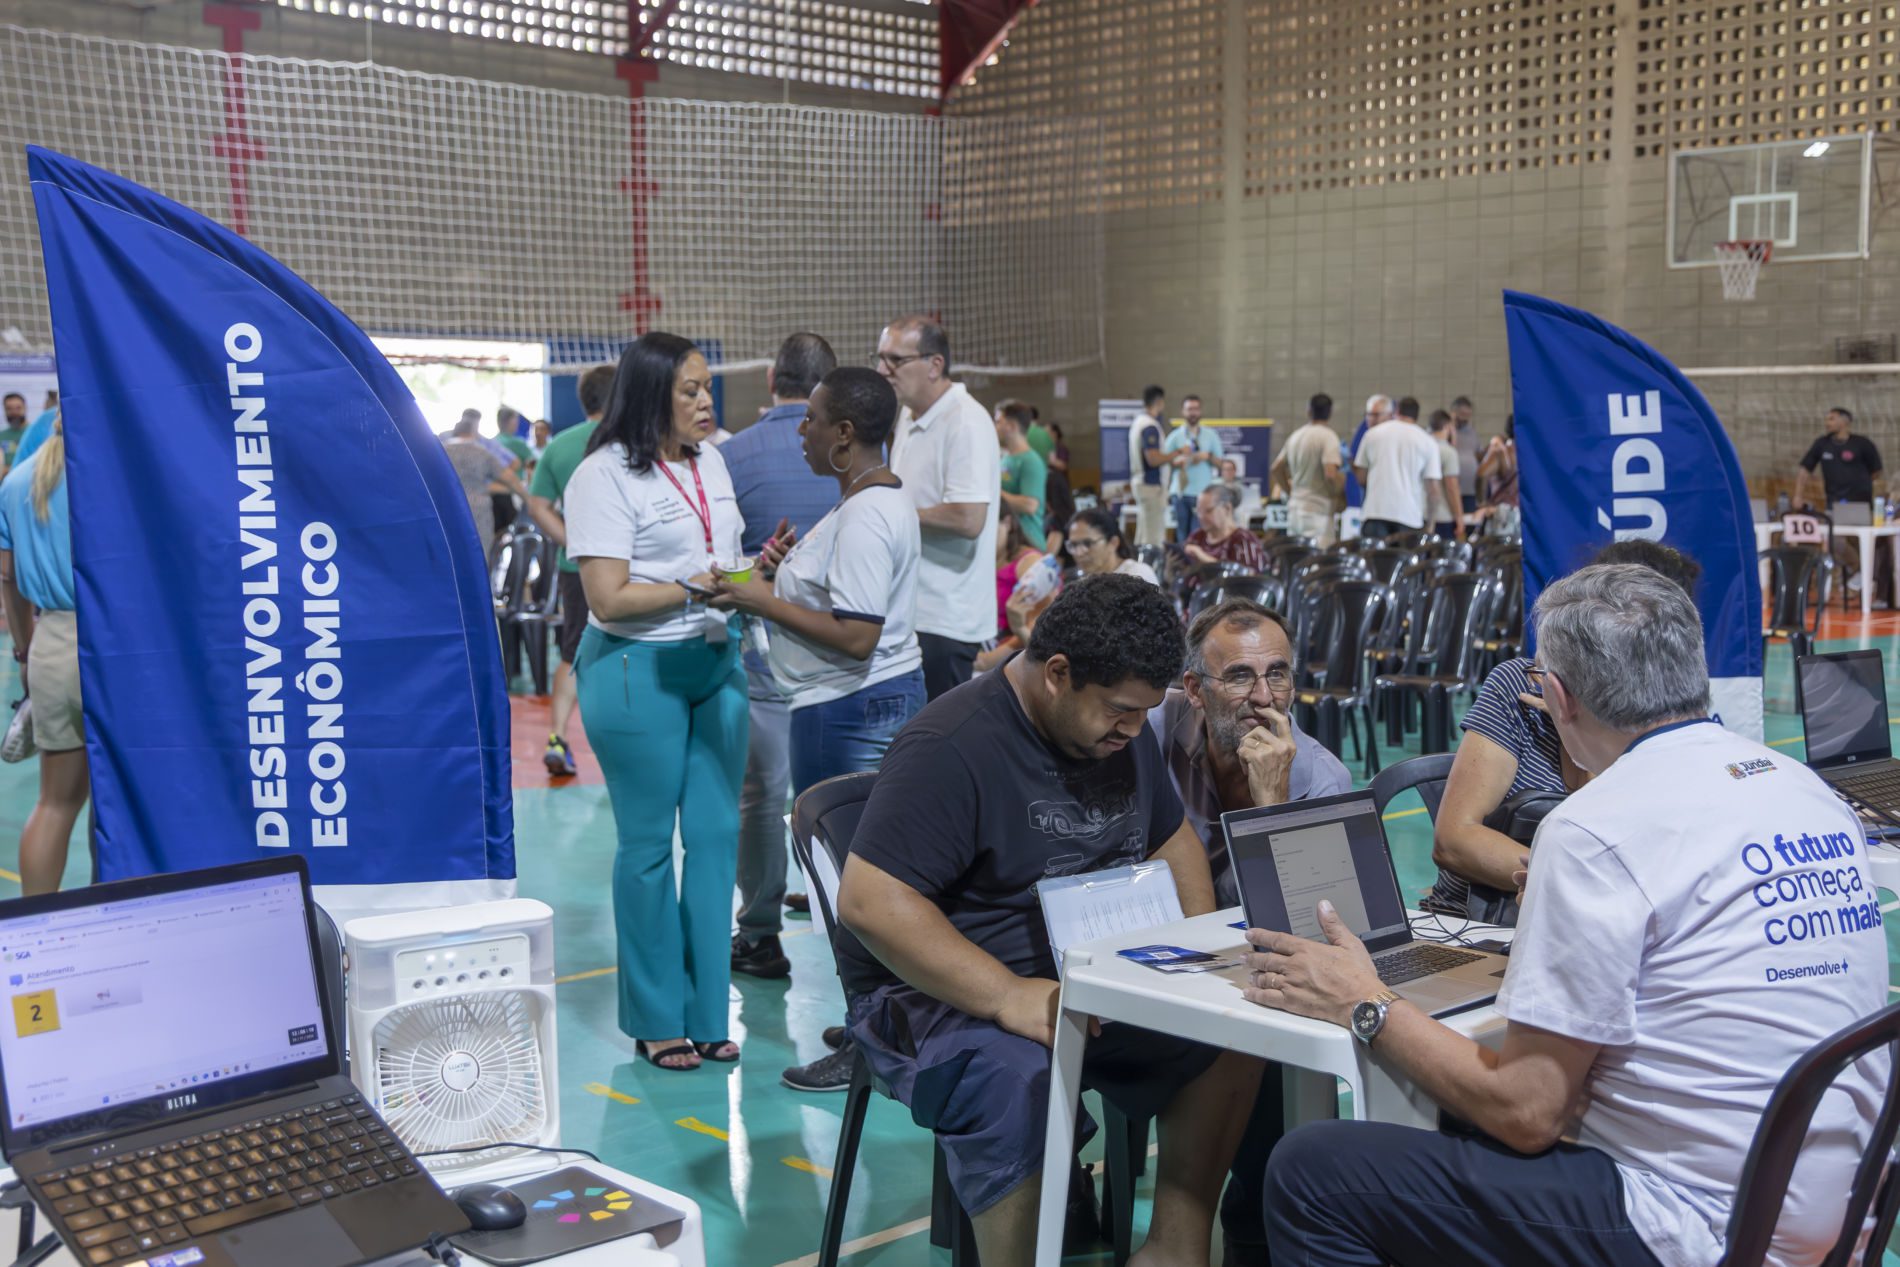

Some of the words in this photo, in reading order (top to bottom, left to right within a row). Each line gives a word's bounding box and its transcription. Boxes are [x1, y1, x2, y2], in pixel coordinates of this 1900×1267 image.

[1597, 390, 1667, 545] ÚDE
[1791, 520, 1815, 535] 10
[223, 322, 290, 848] DESENVOLVIMENTO
[295, 521, 348, 847] ECONÔMICO
[1741, 843, 1774, 876] O
[1773, 831, 1856, 867] futuro
[1753, 865, 1863, 908] começa
[1764, 908, 1836, 945] com
[1837, 892, 1882, 935] mais
[15, 951, 32, 961] SGA
[27, 965, 76, 981] Atendimento
[29, 1004, 43, 1022] 2
